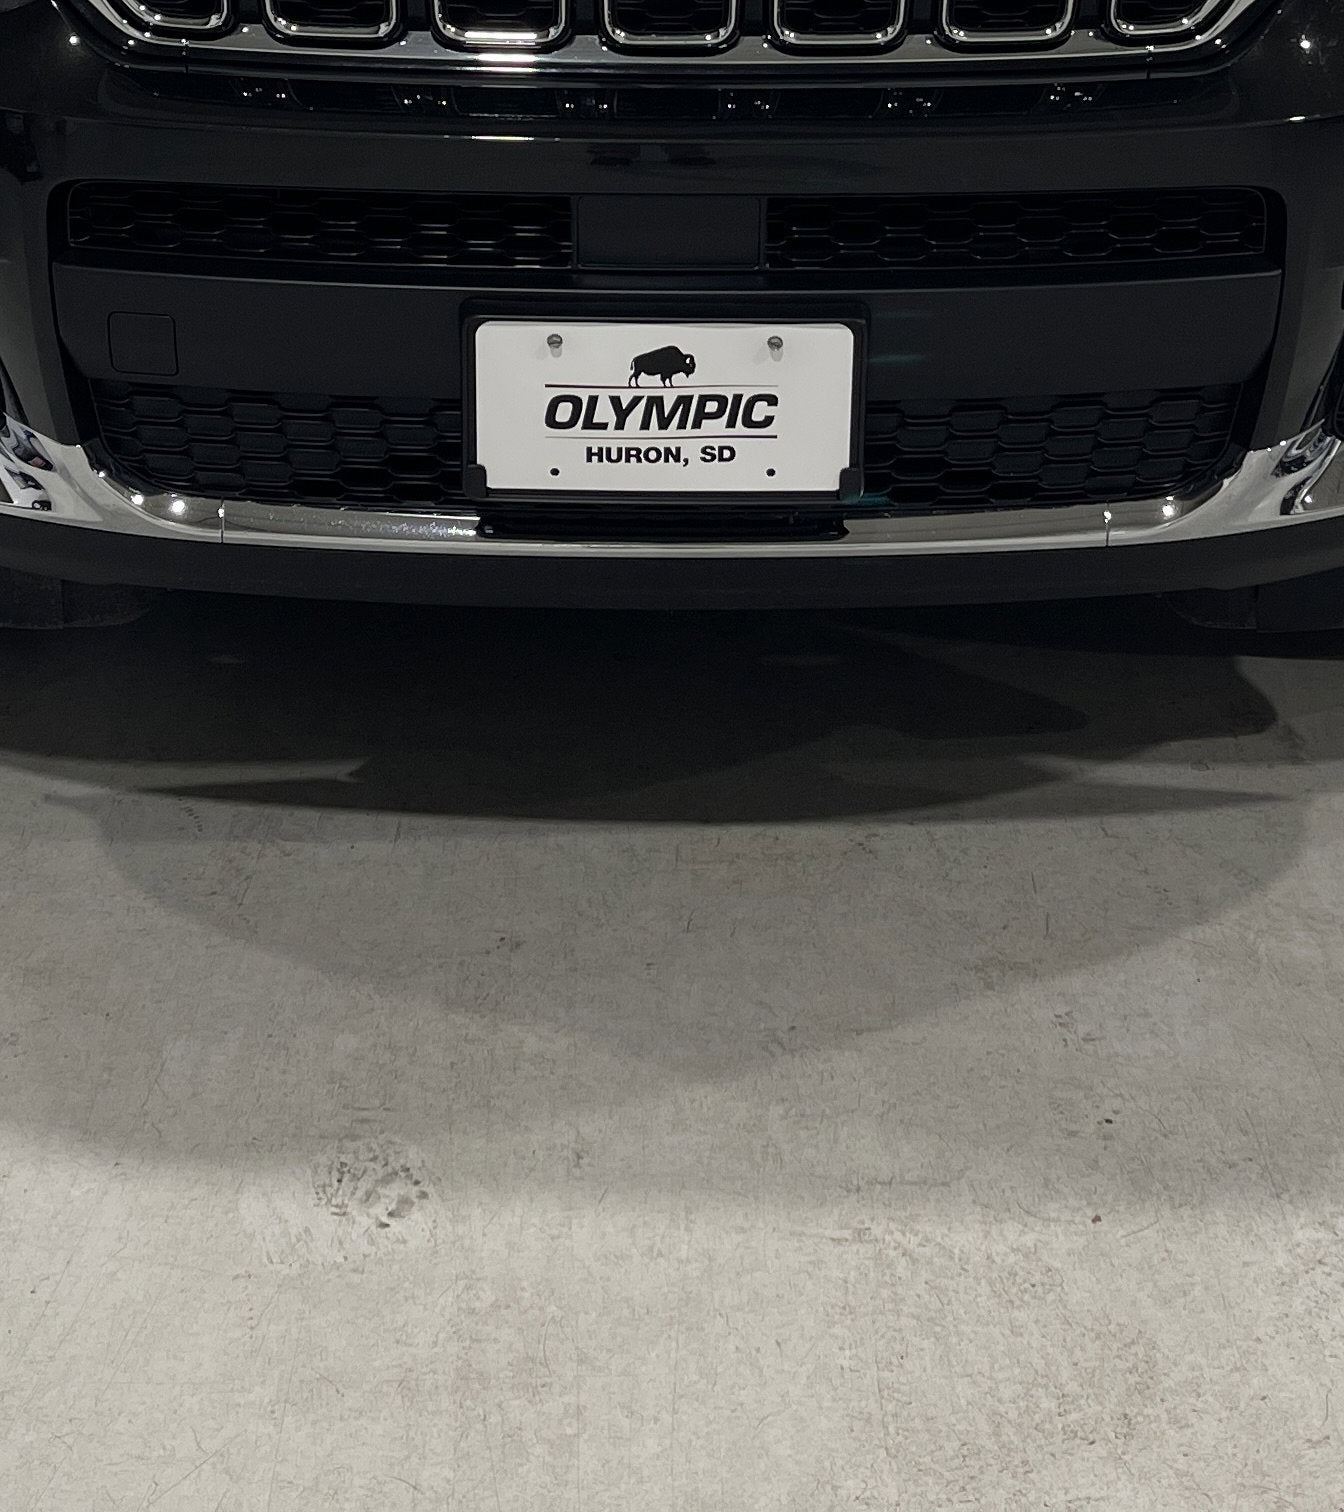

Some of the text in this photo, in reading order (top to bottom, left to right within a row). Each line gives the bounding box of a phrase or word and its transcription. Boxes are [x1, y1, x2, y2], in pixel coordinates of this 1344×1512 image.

[544, 394, 778, 431] OLYMPIC
[586, 445, 735, 467] HURON, SD
